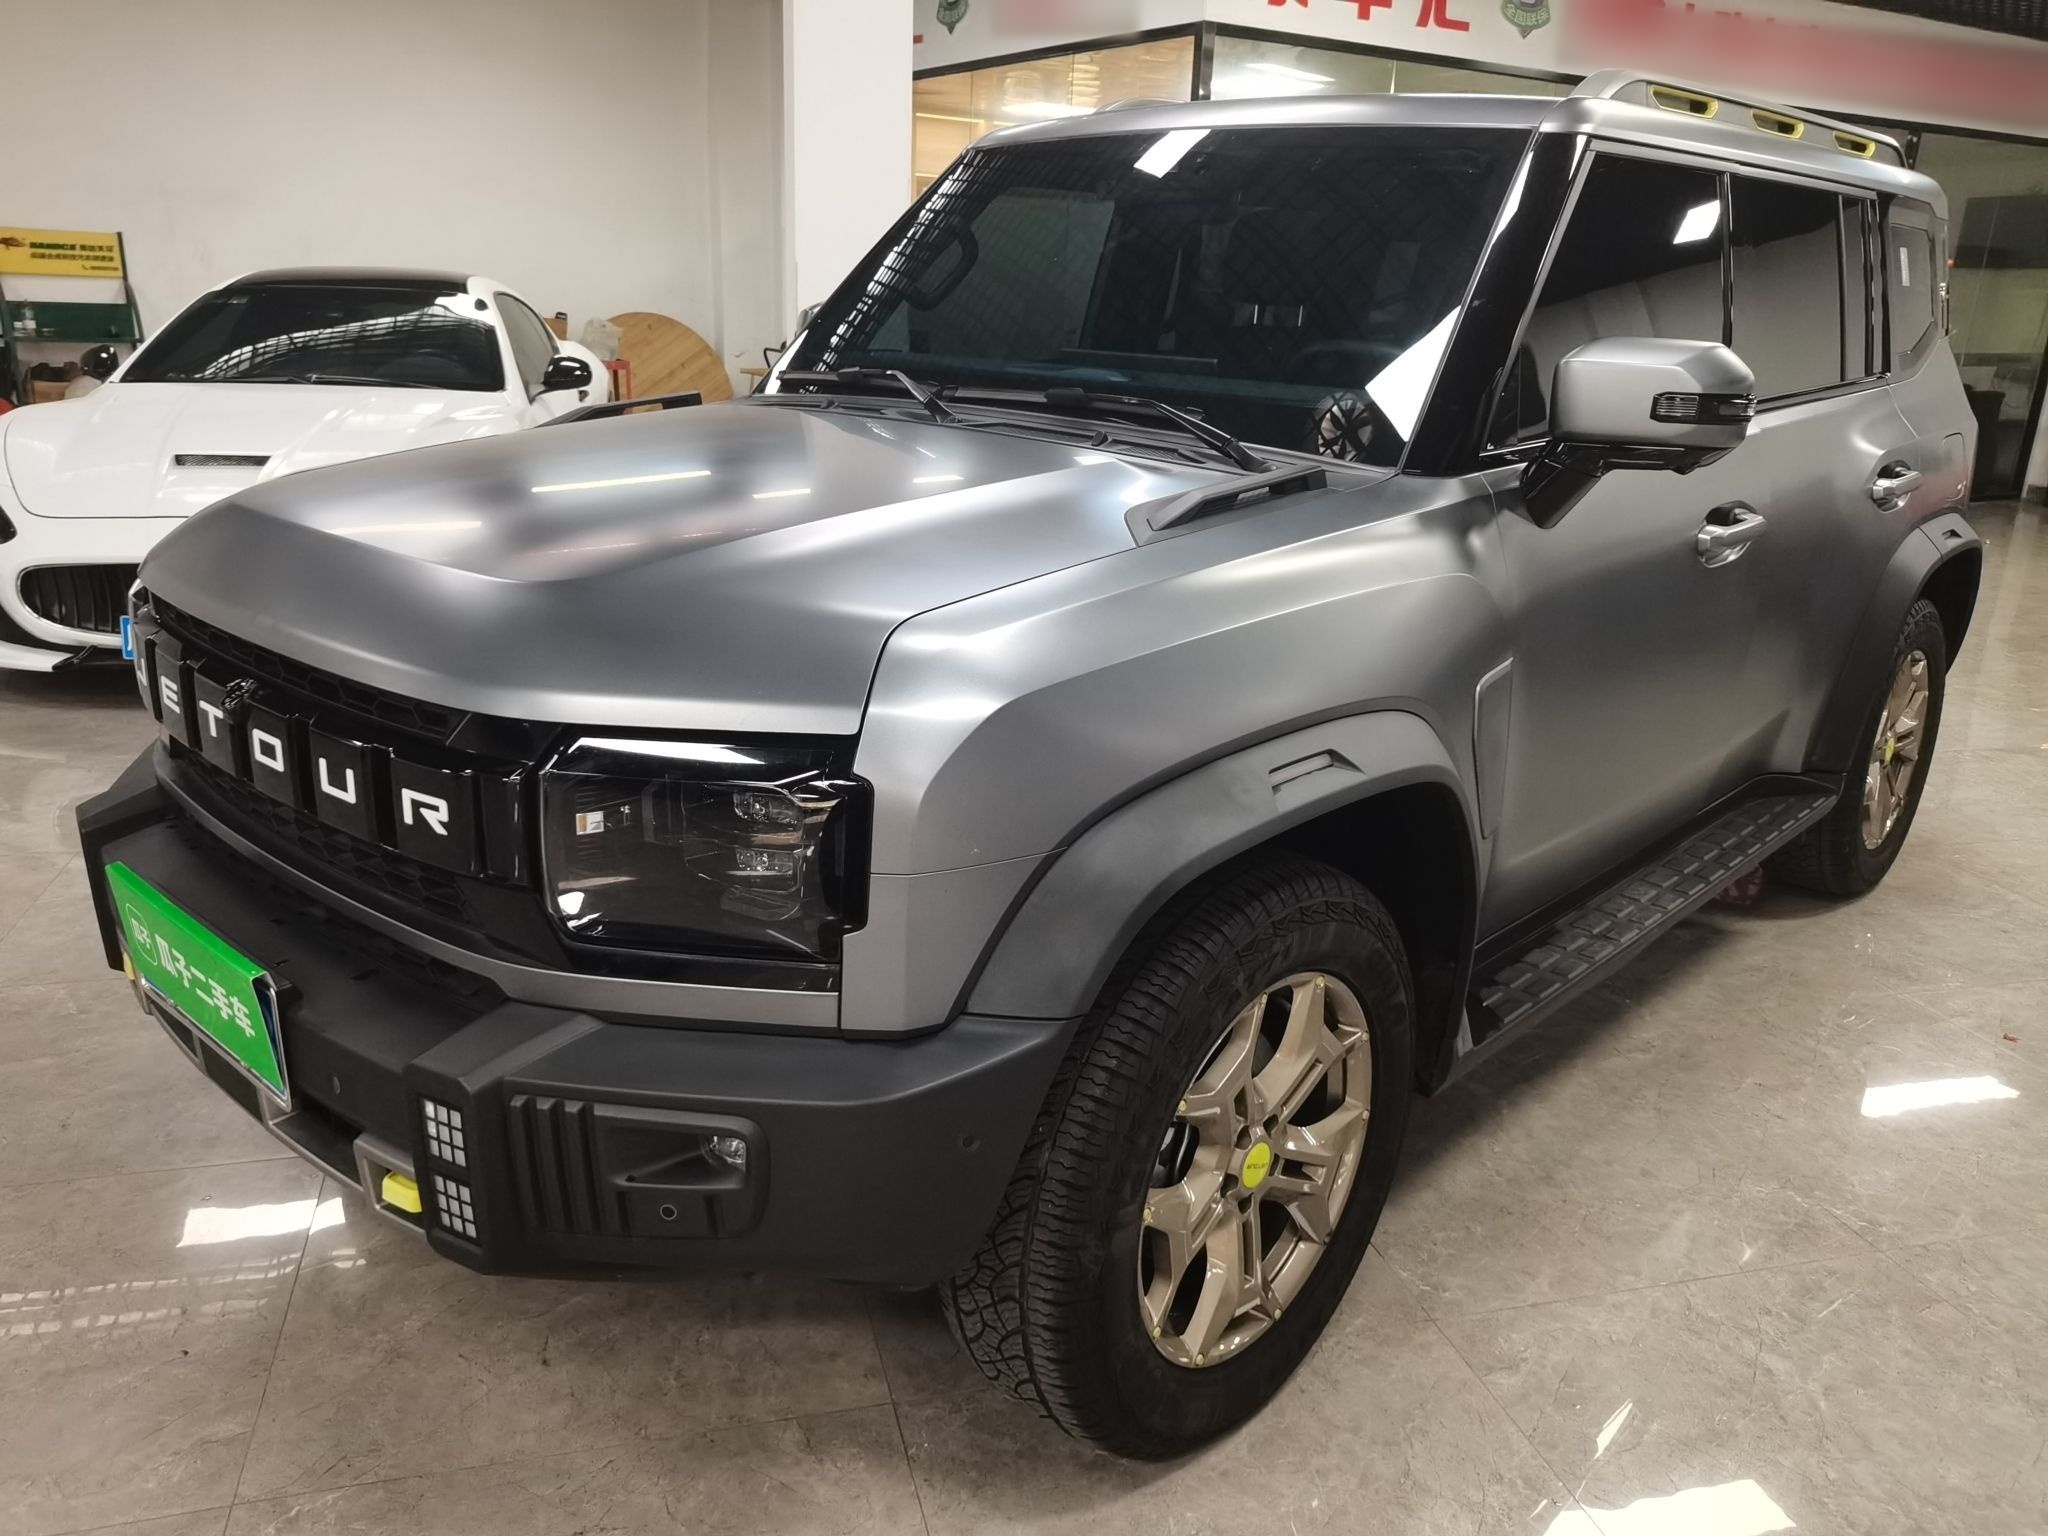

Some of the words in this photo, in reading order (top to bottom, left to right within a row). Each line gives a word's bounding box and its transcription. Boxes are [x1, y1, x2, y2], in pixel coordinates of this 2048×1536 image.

[154, 933, 256, 1038] 瓜子二手车
